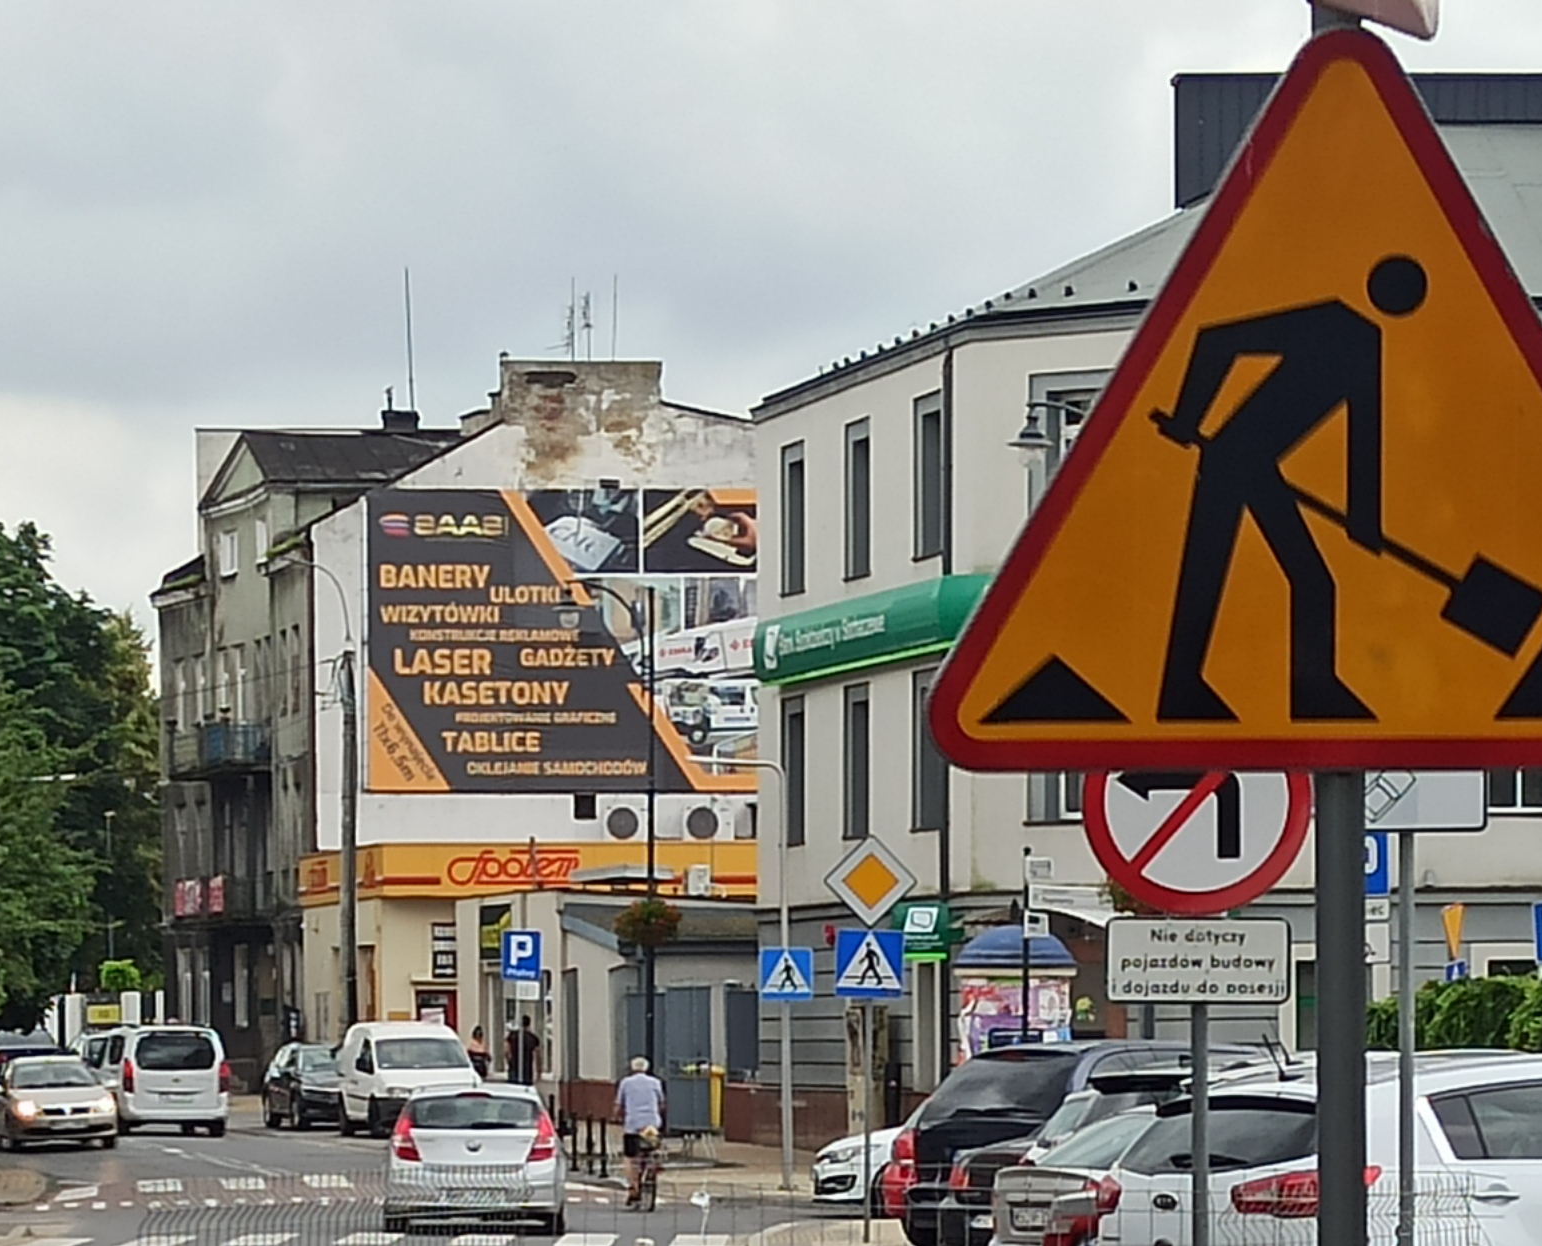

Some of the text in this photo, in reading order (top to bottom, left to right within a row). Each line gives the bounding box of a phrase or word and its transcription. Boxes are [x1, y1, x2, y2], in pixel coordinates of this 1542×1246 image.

[379, 564, 491, 588] BANERY
[489, 585, 560, 604] ULOTKI
[380, 602, 501, 623] WIZYTÓWKI
[393, 647, 493, 675] LASER
[519, 644, 615, 667] GADŻETY
[422, 680, 569, 705] KASETONY
[441, 731, 541, 752] TABLICE
[1150, 928, 1246, 947] Nie dotyczy
[510, 934, 533, 966] P
[1121, 953, 1276, 974] pojazdów budowy
[1122, 979, 1191, 997] dojazdu
[1196, 980, 1219, 994] do
